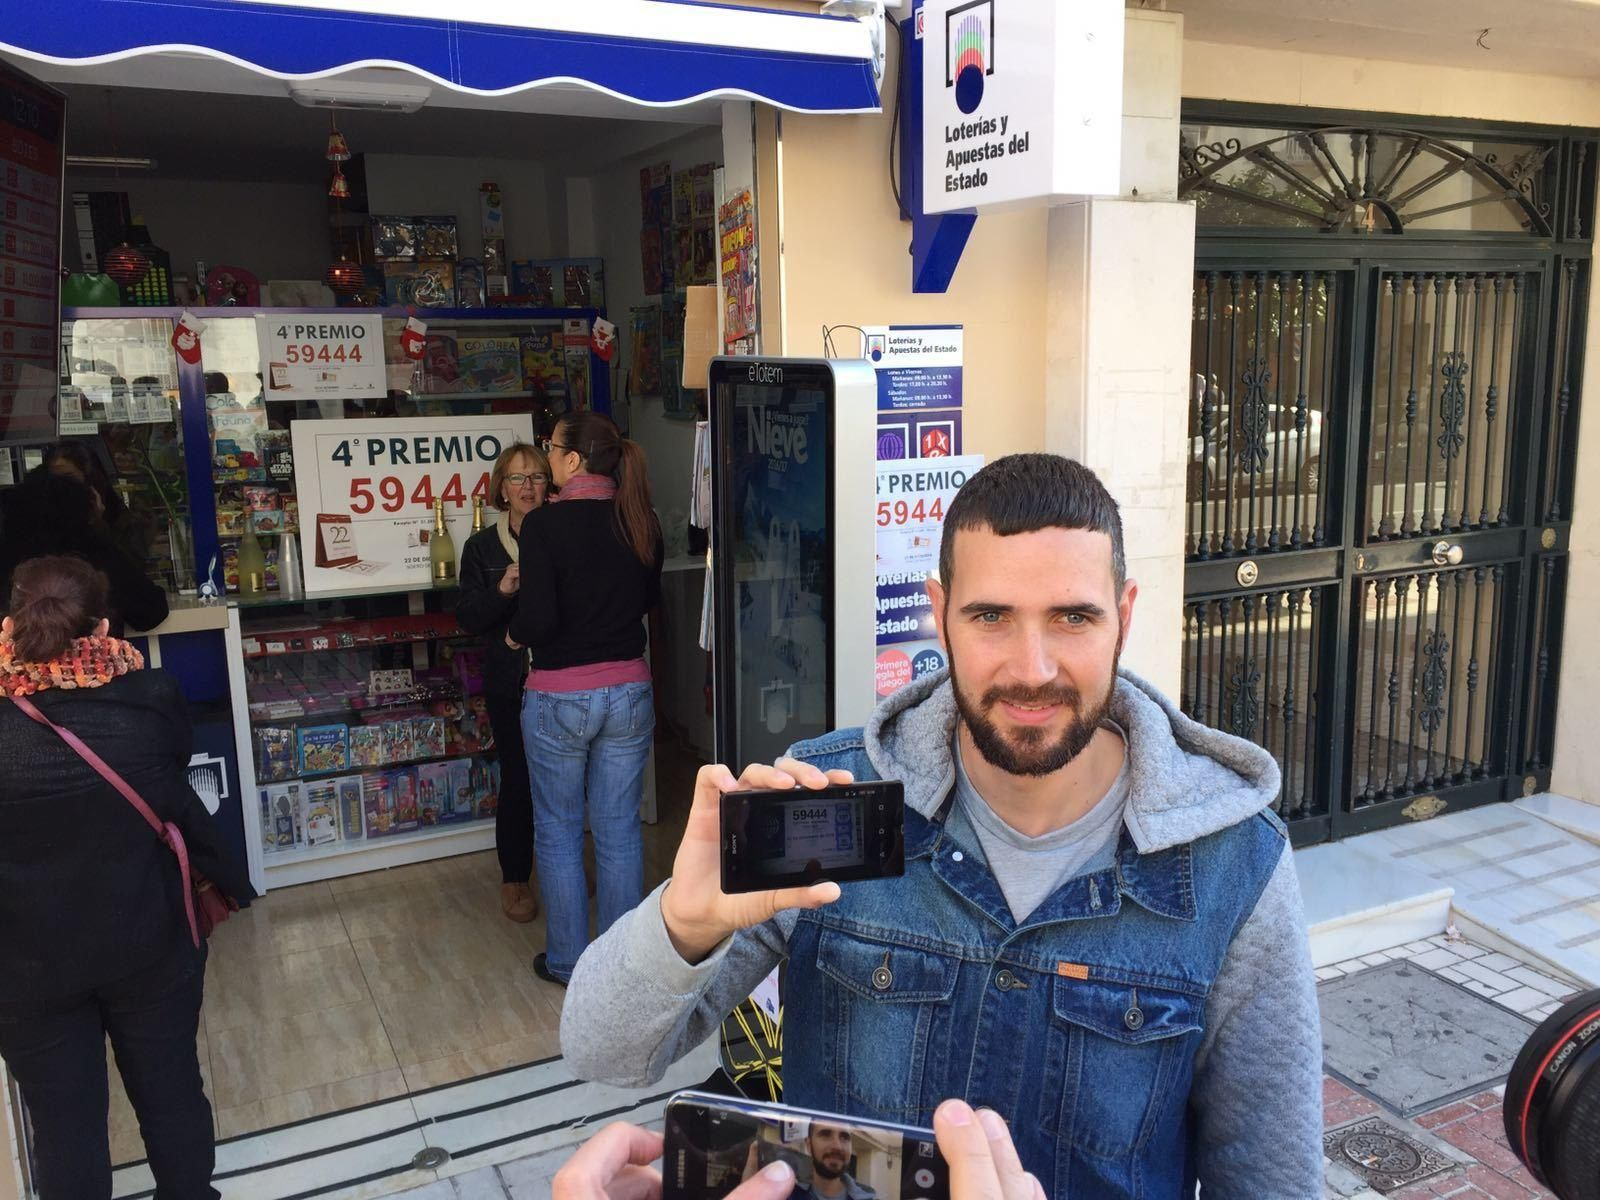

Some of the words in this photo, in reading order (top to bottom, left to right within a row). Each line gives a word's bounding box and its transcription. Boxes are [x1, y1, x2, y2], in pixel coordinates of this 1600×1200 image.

[945, 116, 996, 143] Loterías
[1000, 115, 1008, 135] y
[945, 142, 1004, 171] Apuestas
[1008, 131, 1029, 155] del
[945, 168, 988, 192] Estado
[295, 325, 365, 339] PREMIO
[286, 344, 362, 363] 59444
[889, 346, 920, 355] Apuestas
[934, 345, 957, 353] Estado
[748, 363, 783, 383] eTotem
[747, 405, 808, 465] Nieve
[367, 435, 501, 466] PREMIO
[350, 472, 493, 514] 59444
[889, 470, 966, 493] PREMIO
[877, 497, 944, 526] 5944
[330, 526, 350, 544] 22
[875, 669, 895, 680] egla
[897, 666, 910, 676] del
[915, 656, 939, 671] +18
[792, 808, 827, 821] 59444
[1550, 1040, 1577, 1073] CANON
